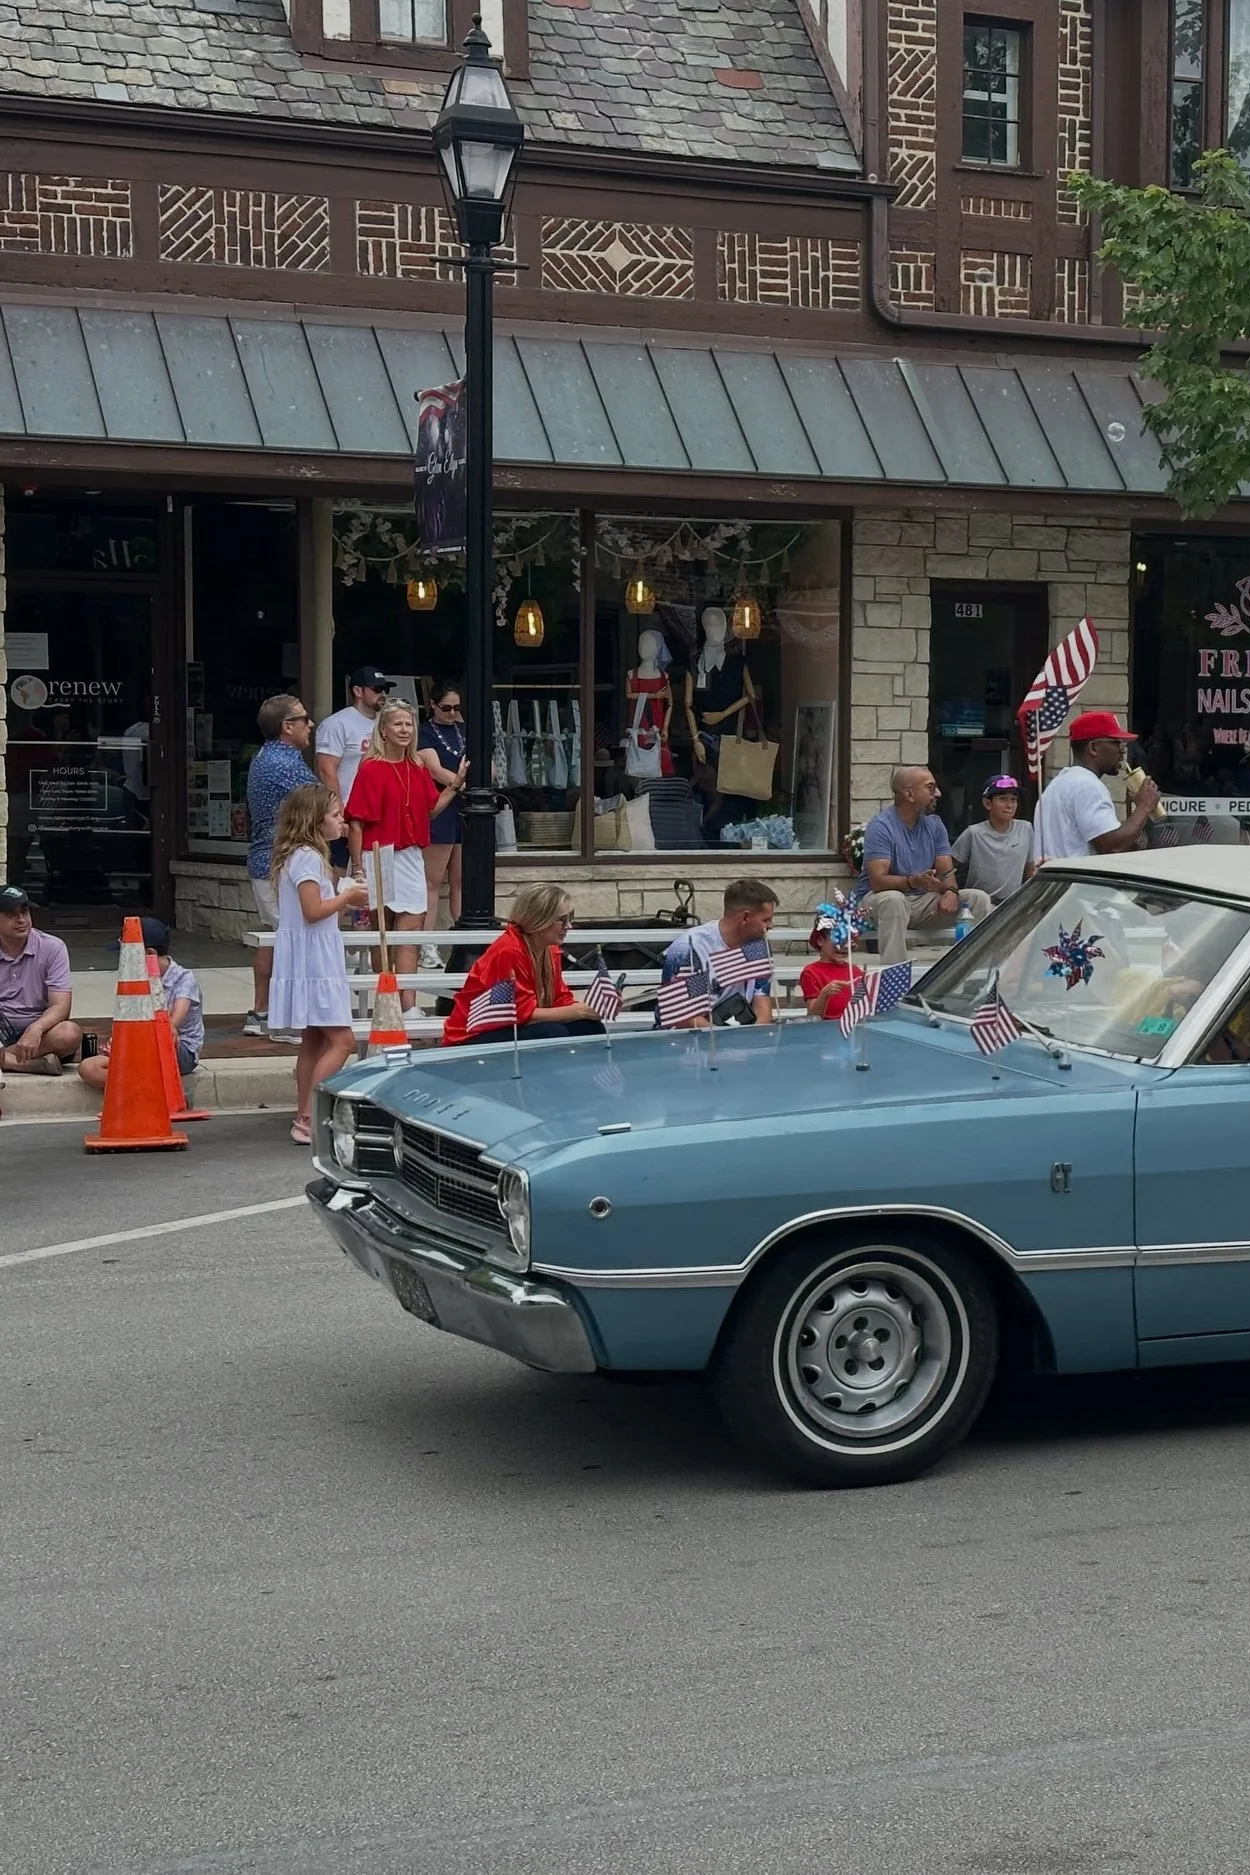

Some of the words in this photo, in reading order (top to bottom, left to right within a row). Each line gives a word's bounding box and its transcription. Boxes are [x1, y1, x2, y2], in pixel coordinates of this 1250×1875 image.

[956, 604, 980, 617] 481
[49, 680, 123, 696] renew
[52, 767, 85, 776] HOURS
[1162, 800, 1206, 812] NICURE
